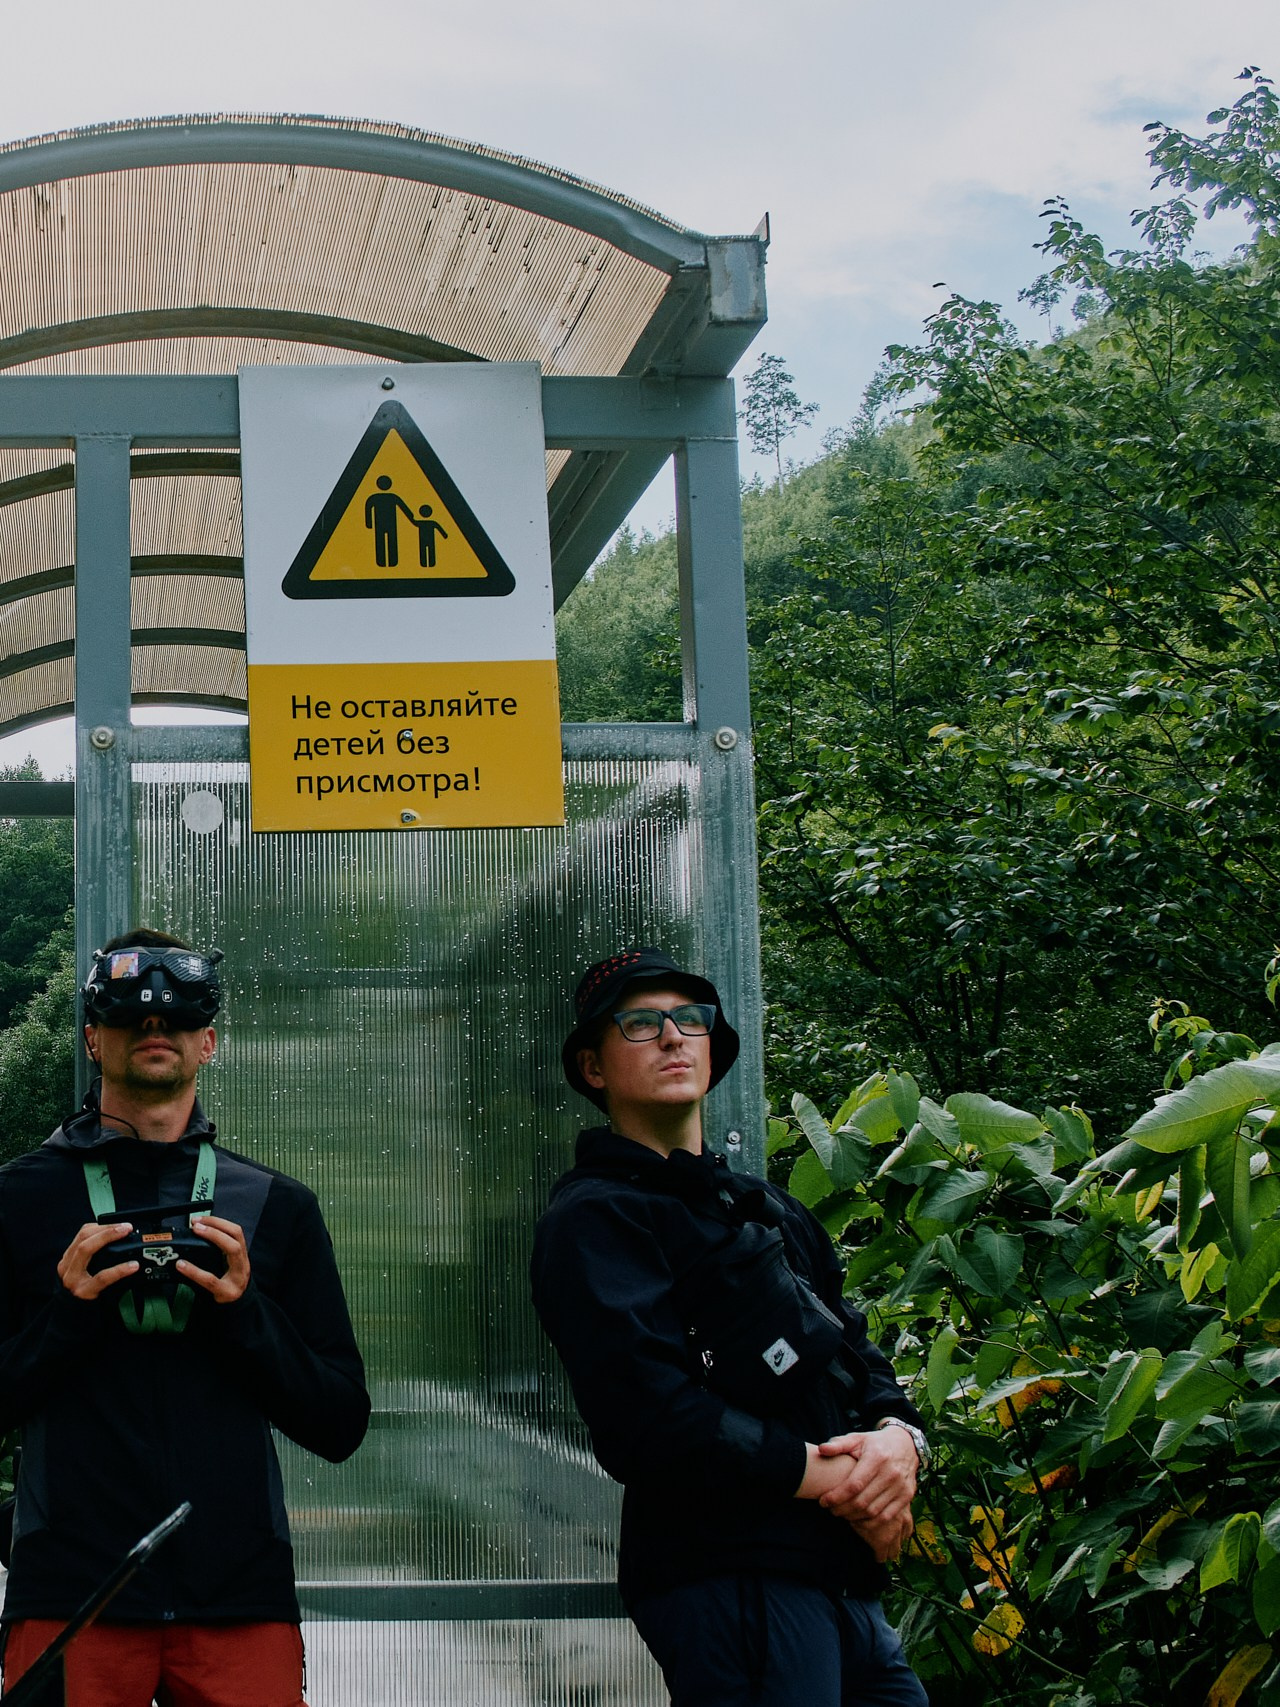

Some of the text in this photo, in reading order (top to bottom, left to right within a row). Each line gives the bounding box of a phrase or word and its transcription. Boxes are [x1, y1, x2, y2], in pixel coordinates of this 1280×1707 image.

[292, 690, 518, 719] Не оставляйте
[293, 728, 450, 761] детей без
[296, 766, 480, 801] присмотра!
